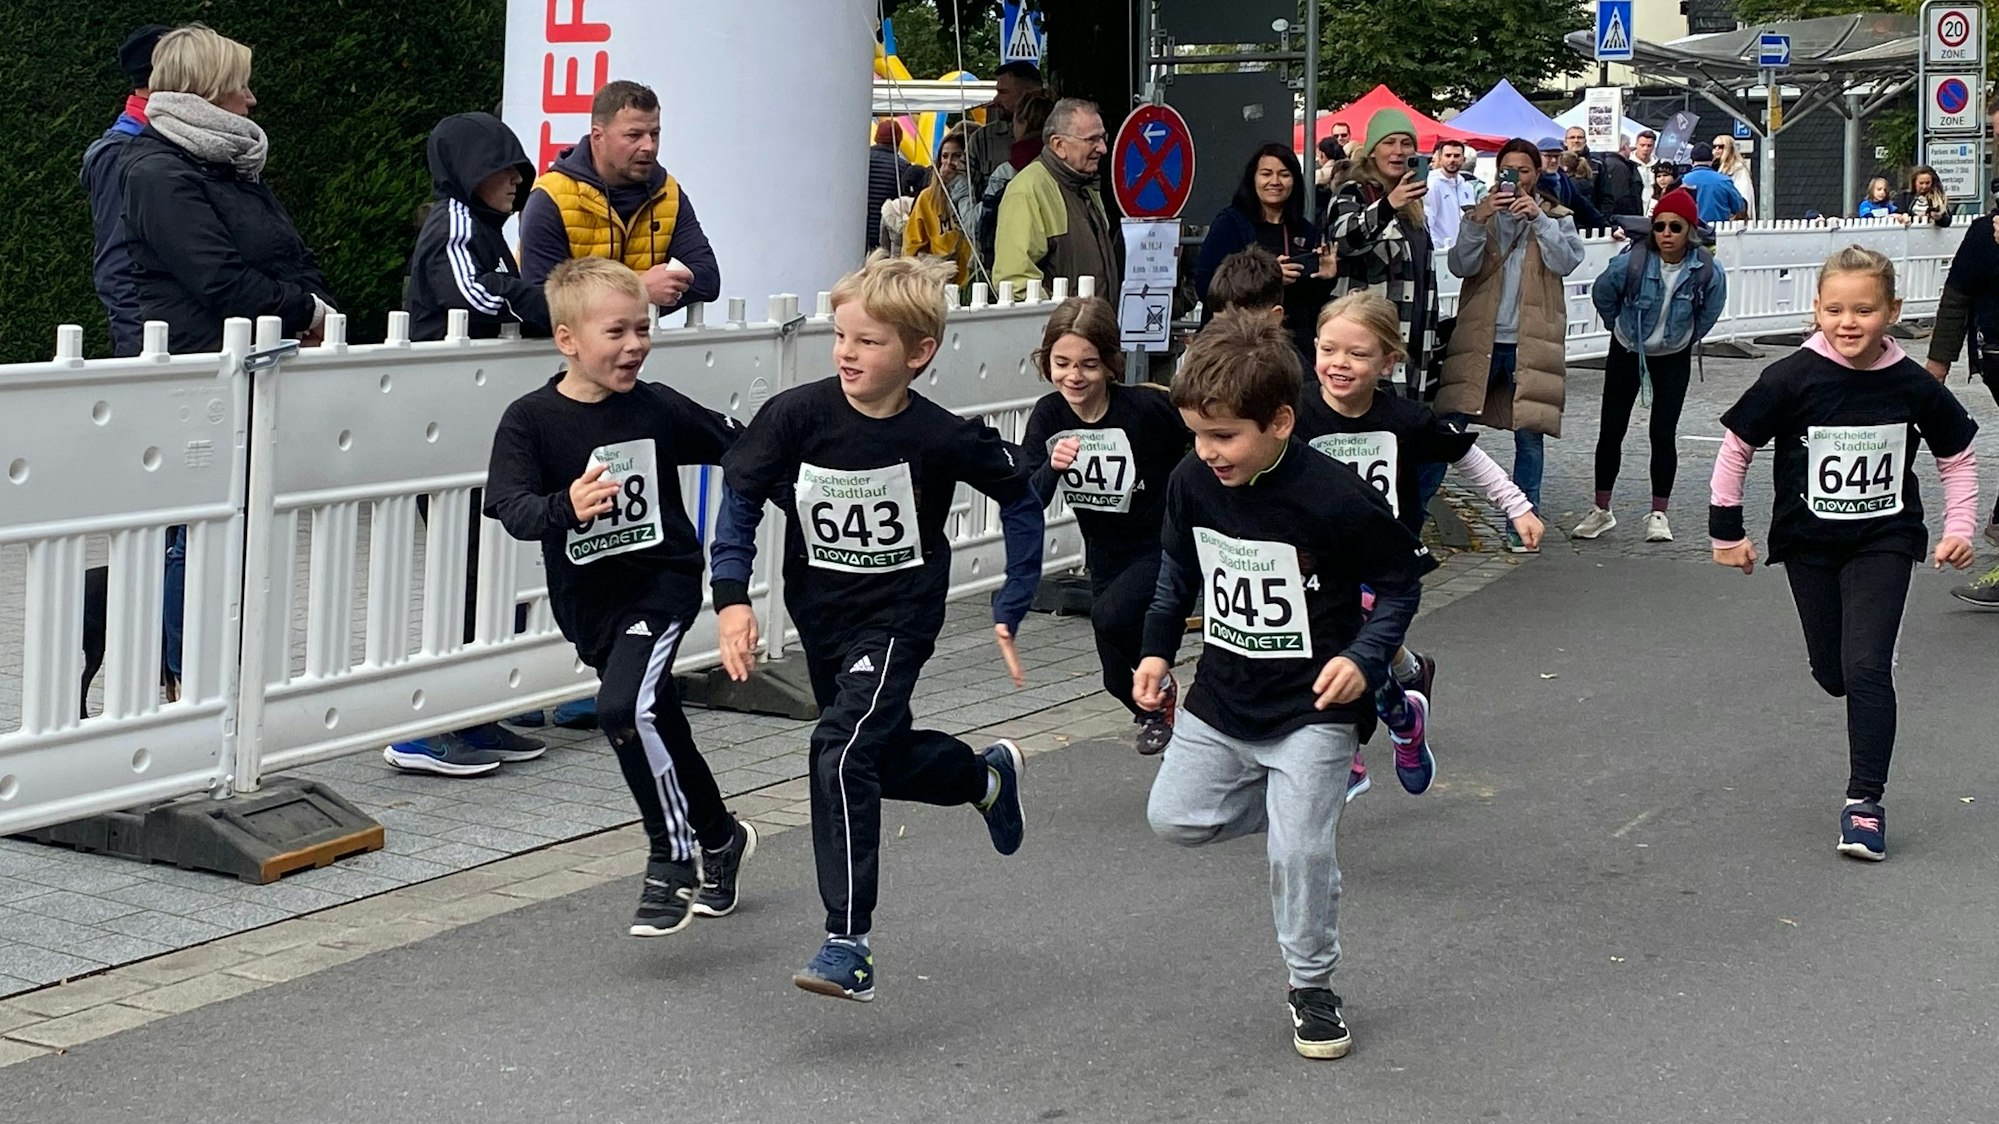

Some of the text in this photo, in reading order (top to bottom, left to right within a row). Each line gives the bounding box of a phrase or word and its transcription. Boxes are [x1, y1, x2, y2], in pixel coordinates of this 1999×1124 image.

[1945, 21, 1963, 37] 20
[1941, 50, 1966, 59] ZONE
[1940, 116, 1964, 126] ZONE
[1324, 445, 1380, 457] Stadtlauf
[1833, 439, 1888, 451] Stadtlauf
[1063, 456, 1126, 490] 647
[1819, 453, 1894, 494] 644
[821, 485, 888, 498] Stadtlauf
[1814, 497, 1894, 512] NOVANETZ
[811, 500, 905, 547] 643
[815, 547, 911, 566] NOVANETZ
[1213, 567, 1292, 627] 645
[1211, 623, 1300, 649] NOVANETZ
